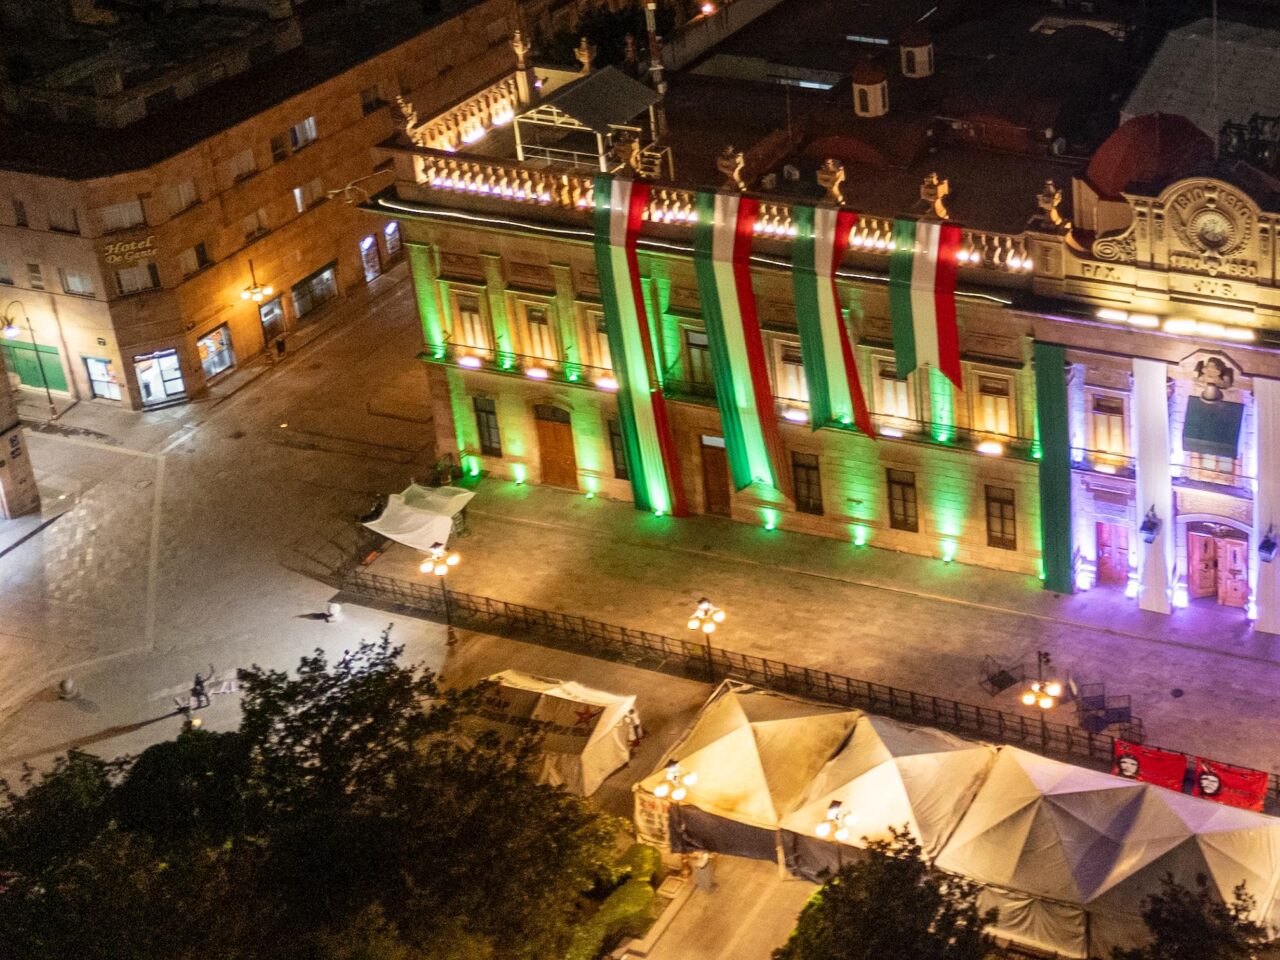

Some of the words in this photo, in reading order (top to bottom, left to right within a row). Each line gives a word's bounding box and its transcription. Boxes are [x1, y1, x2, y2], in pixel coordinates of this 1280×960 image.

[1173, 188, 1203, 210] 1810
[105, 235, 155, 256] Hotel
[105, 254, 123, 264] De
